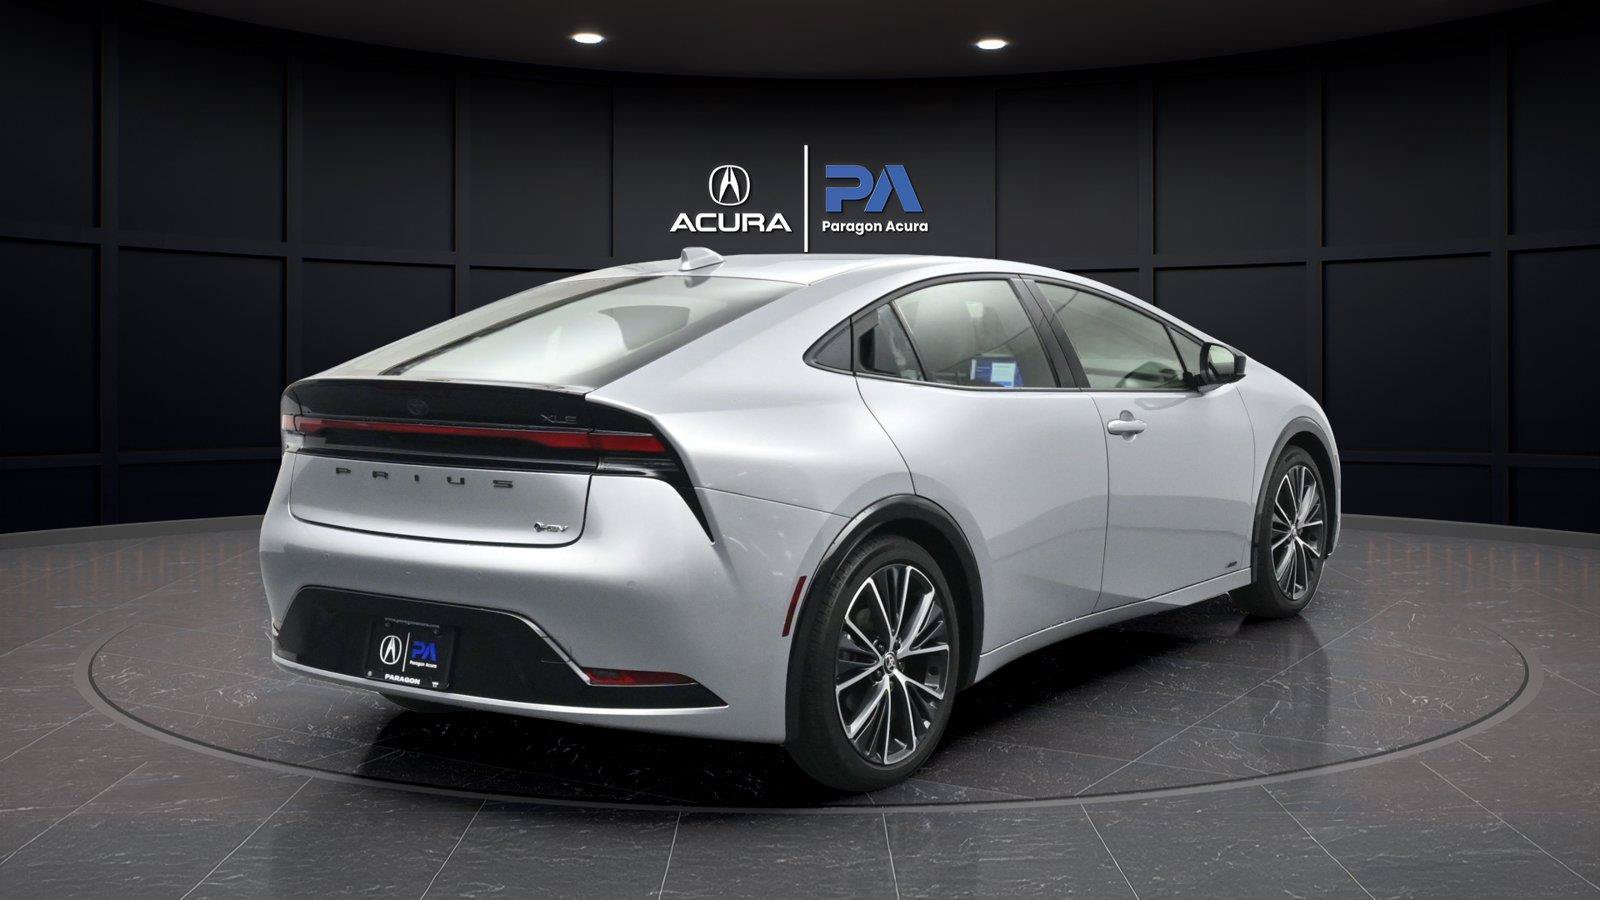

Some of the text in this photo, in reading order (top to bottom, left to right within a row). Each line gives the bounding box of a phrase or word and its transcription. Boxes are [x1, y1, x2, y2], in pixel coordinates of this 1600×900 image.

[825, 164, 924, 213] PA
[670, 213, 793, 232] ACURA
[822, 220, 929, 235] Paragon Acura
[335, 467, 514, 488] PRIUS
[412, 641, 437, 661] PA
[384, 673, 421, 685] PARAGON
